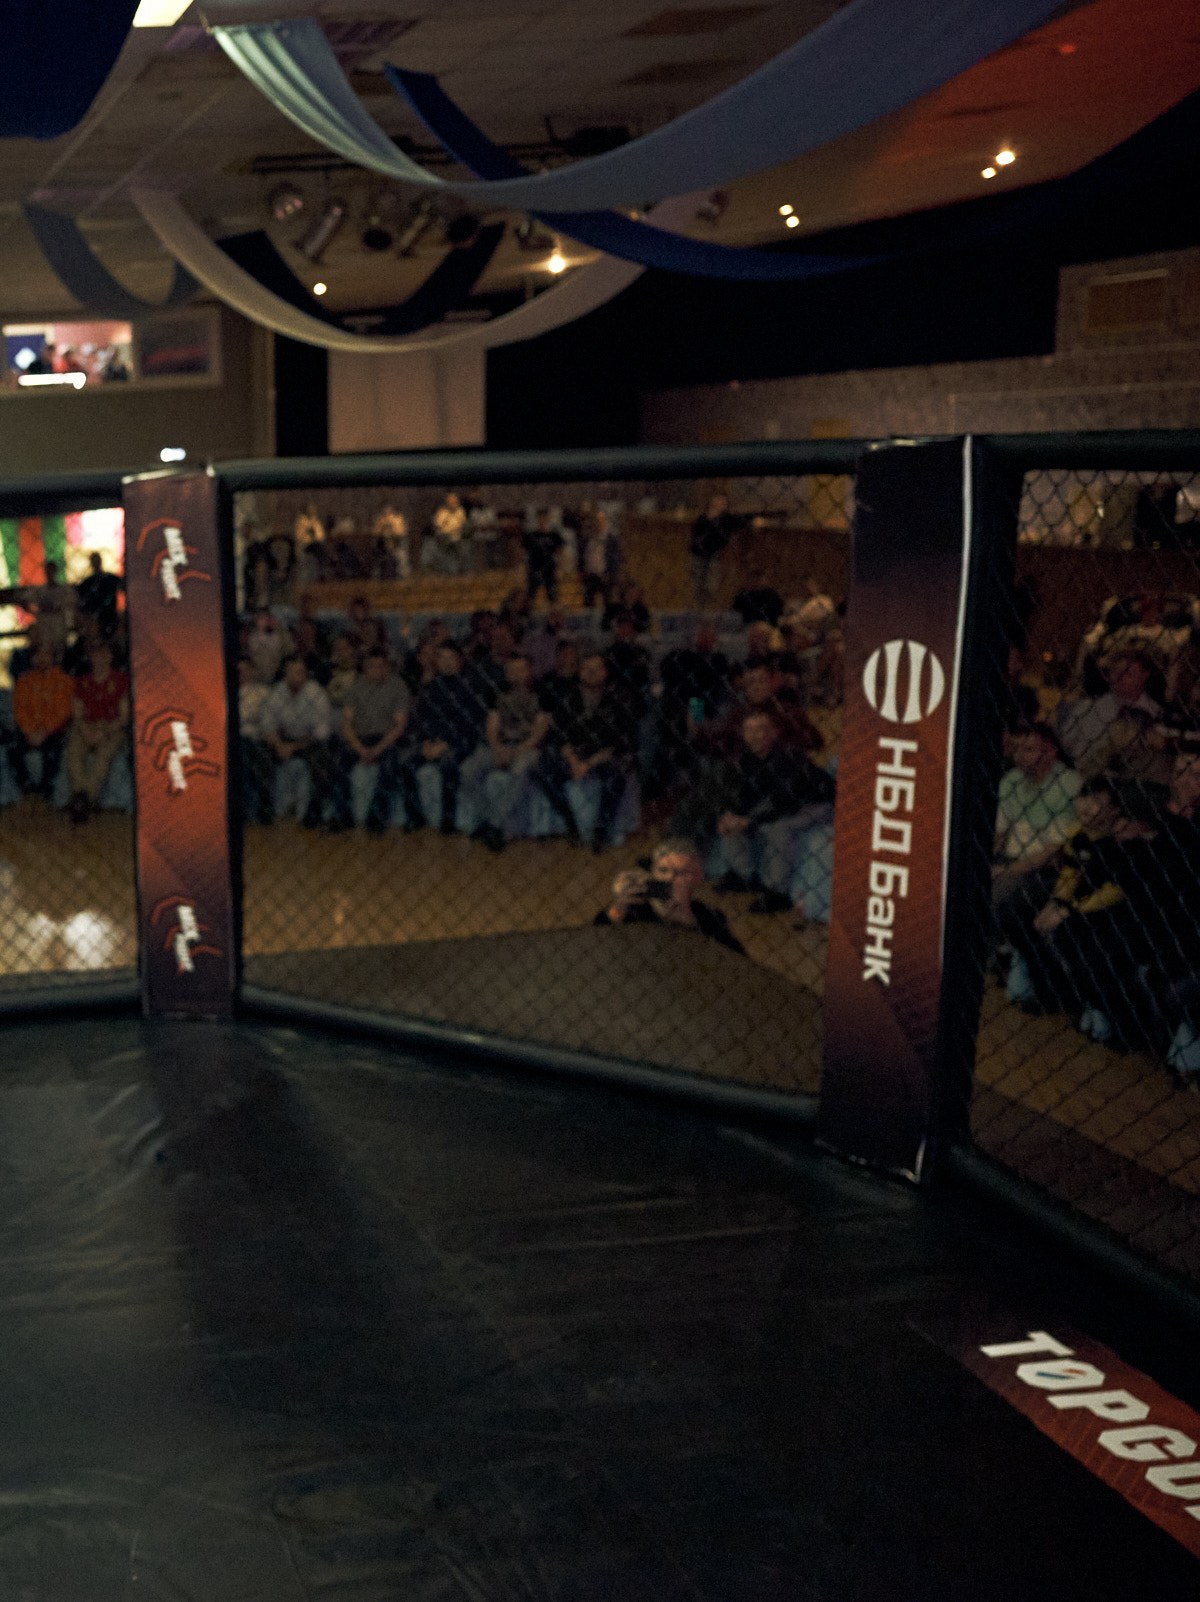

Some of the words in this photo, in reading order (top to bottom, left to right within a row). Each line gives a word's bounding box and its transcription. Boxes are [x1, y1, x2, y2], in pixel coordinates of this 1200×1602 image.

[871, 736, 918, 855] НБД
[862, 860, 909, 985] Банк
[980, 1331, 1200, 1522] TOPGU
